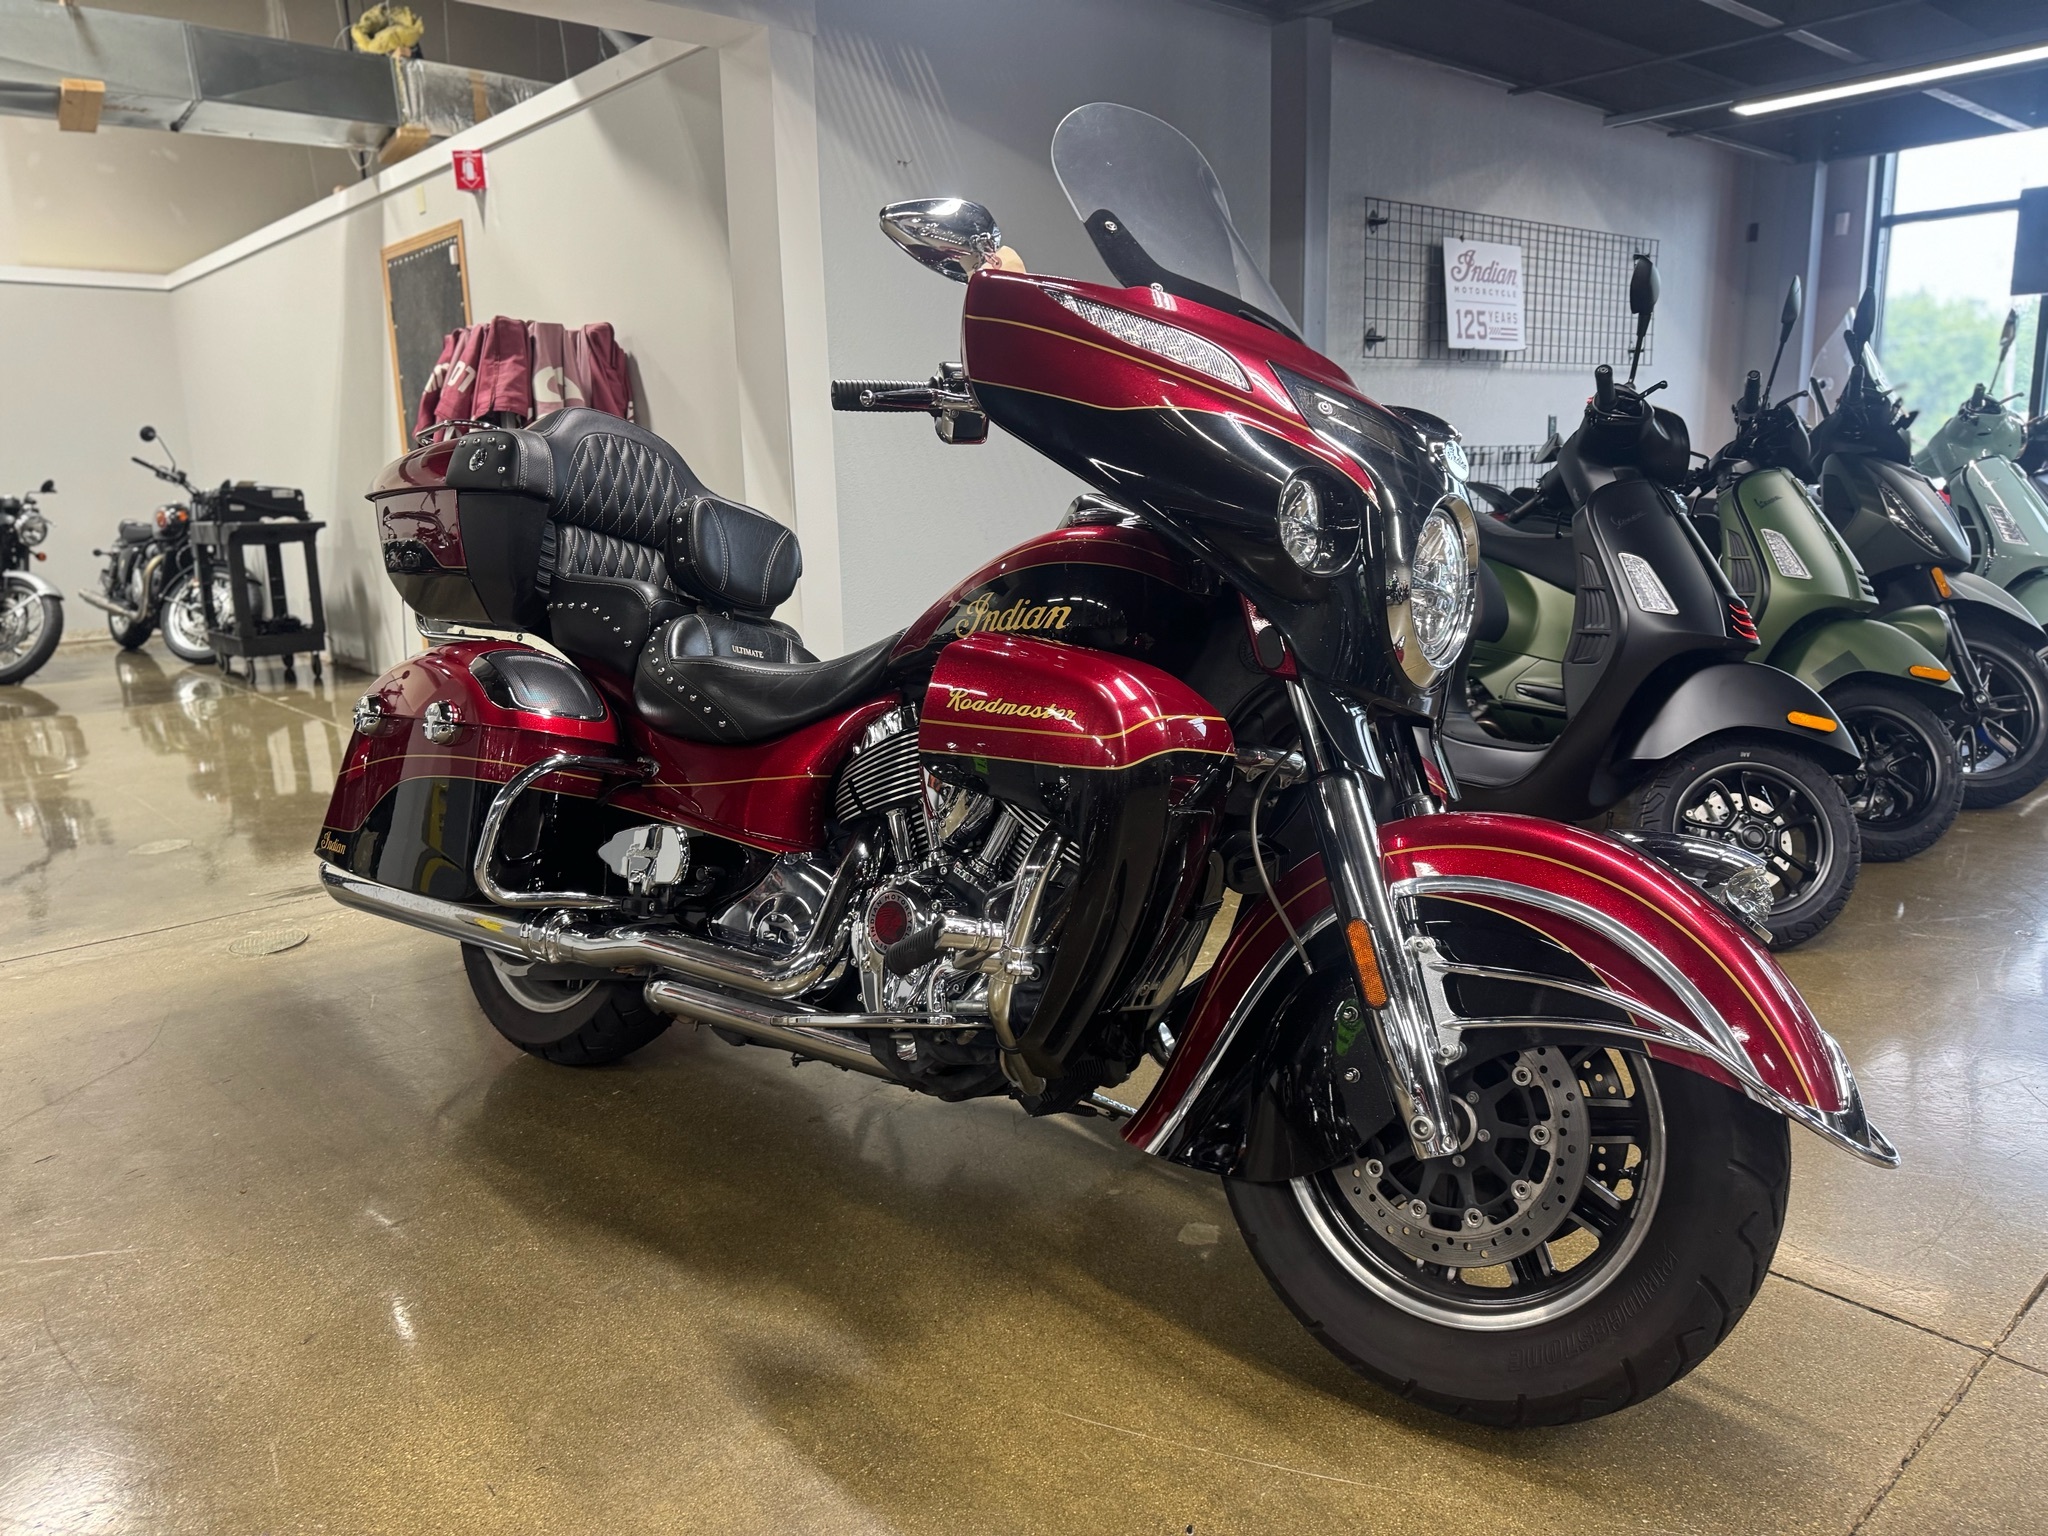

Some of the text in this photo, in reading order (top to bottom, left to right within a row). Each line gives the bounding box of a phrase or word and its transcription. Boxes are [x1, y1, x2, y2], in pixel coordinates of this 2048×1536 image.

[1450, 249, 1517, 286] Indian
[1454, 285, 1517, 298] MOTORCYCLE
[1456, 309, 1518, 340] 125 YEARS
[955, 591, 1072, 639] Indian
[731, 644, 765, 659] ULTIMATE
[946, 689, 1077, 721] Roadmaster
[321, 831, 347, 855] Indian
[870, 894, 913, 940] INDIAN MOTORCYCL
